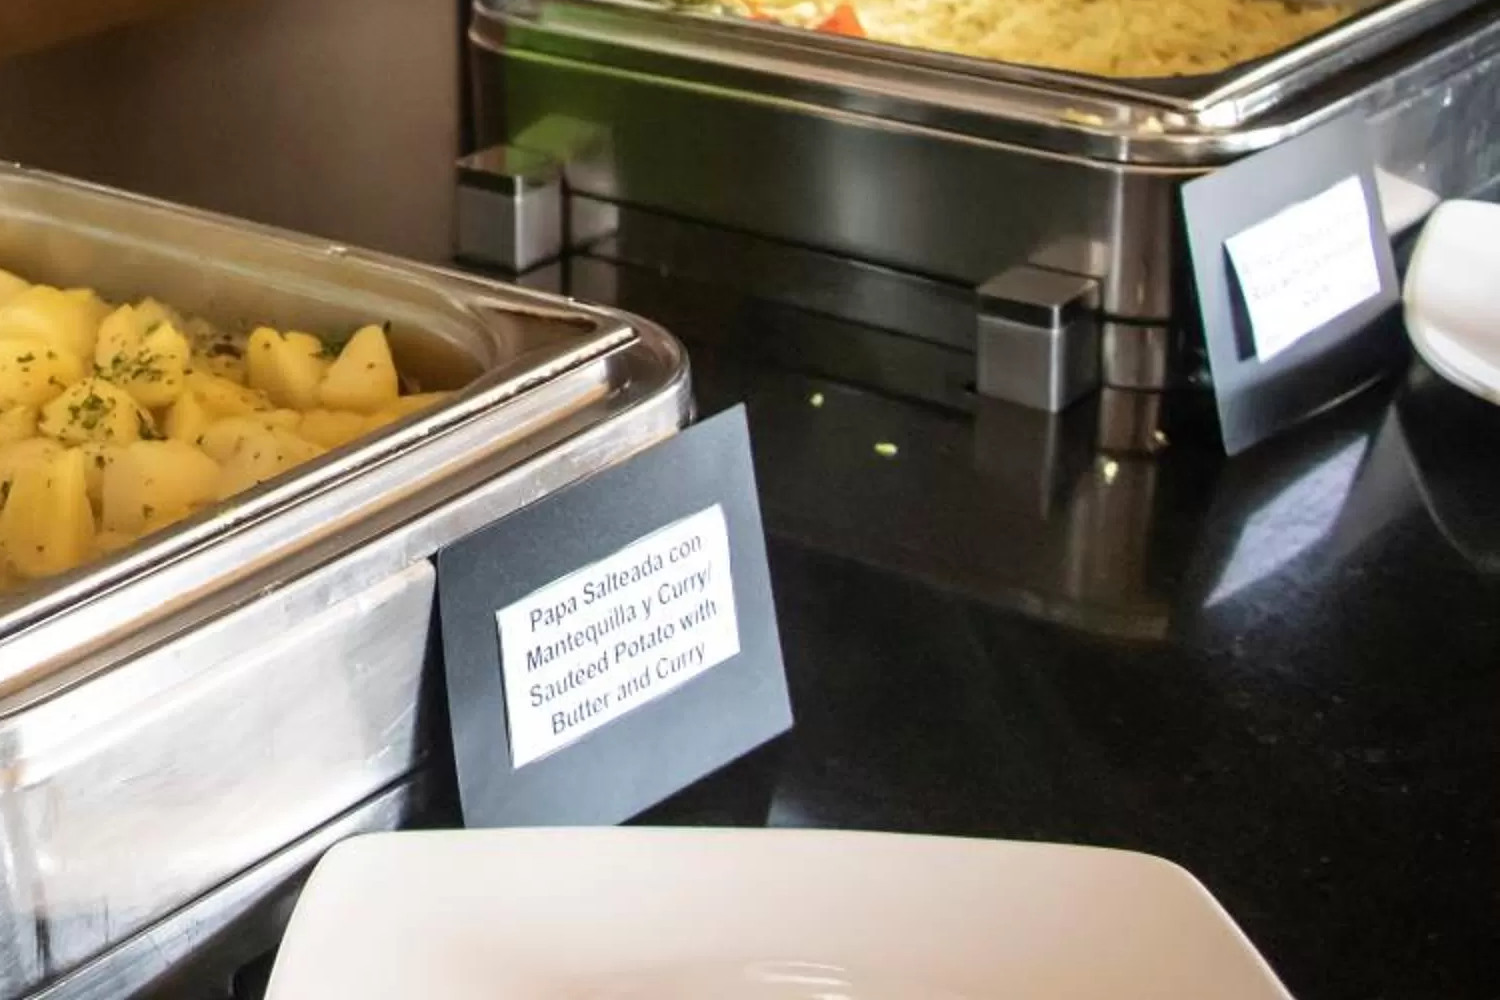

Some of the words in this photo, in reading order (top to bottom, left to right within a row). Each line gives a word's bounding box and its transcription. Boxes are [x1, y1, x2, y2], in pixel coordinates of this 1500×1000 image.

[529, 596, 578, 632] Papa
[583, 552, 663, 605] Salteada
[669, 534, 702, 563] con
[526, 604, 637, 672] Mantequilla
[642, 595, 652, 621] y
[614, 623, 675, 664] Potato
[679, 598, 718, 630] with
[551, 692, 610, 735] Butter
[617, 665, 651, 701] and
[655, 641, 706, 680] Curry
